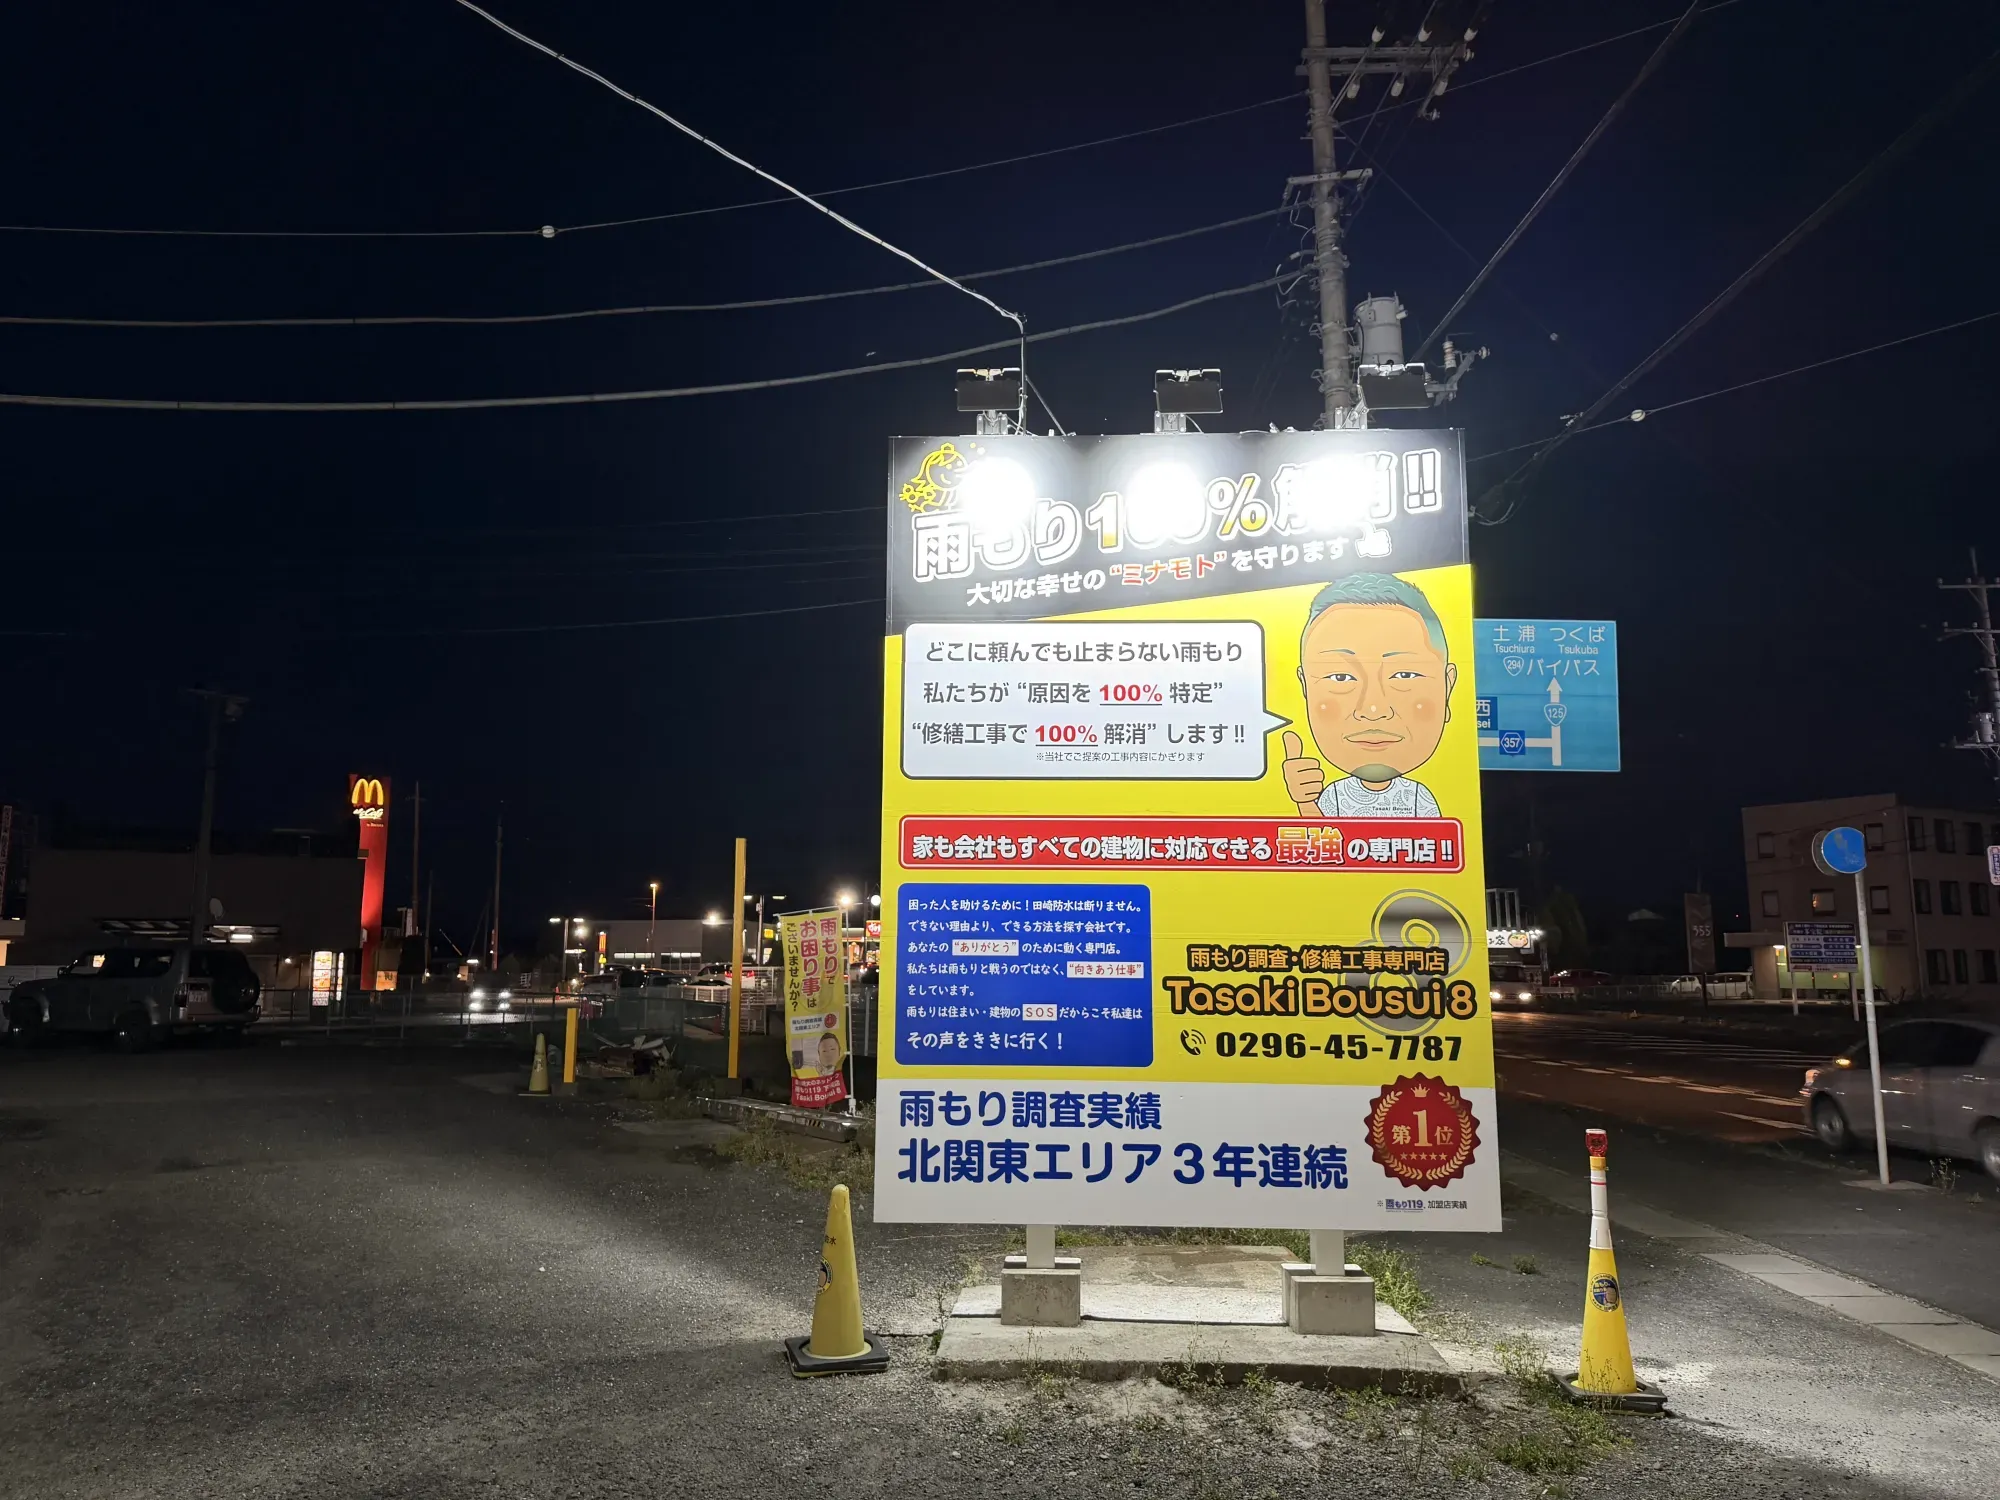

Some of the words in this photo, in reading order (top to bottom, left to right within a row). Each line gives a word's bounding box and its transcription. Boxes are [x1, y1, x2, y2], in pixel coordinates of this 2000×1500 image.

[966, 569, 1105, 606] 大切な幸せの
[1231, 536, 1350, 571] を守ります
[1493, 624, 1536, 642] 土浦
[1550, 626, 1606, 643] つくば
[926, 641, 1243, 663] どこに頼んでも止まらない雨もり
[1494, 644, 1535, 654] Tsuchiura
[1558, 644, 1599, 654] Tsukuba
[1507, 659, 1521, 669] 294
[1527, 658, 1600, 676] バイパス
[923, 681, 1010, 704] 私たちが
[1100, 684, 1163, 702] 100%
[1548, 708, 1564, 719] 125
[1035, 725, 1098, 743] 100%
[1503, 735, 1520, 748] 357
[912, 834, 1273, 861] 家も会社もすべての建物に対応できる
[1276, 826, 1344, 865] 最強
[1347, 836, 1454, 862] の専門店!!
[908, 899, 1142, 912] 困った人を助けるために！田崎防水は断りません。
[908, 920, 1131, 933] できない理由より、できる方法を探す会社です。
[820, 917, 838, 984] 雨もりで
[907, 941, 949, 953] あなたの
[1022, 942, 1121, 955] のために動く専門店。
[800, 920, 820, 1008] お困り事は
[1189, 946, 1446, 973] 雨もり調査・修繕工事専門店
[907, 963, 1065, 976] 私たちは雨もりと戦うのではなく、
[907, 984, 975, 997] をしています。
[1164, 976, 1298, 1014] Tasaki
[1304, 977, 1443, 1016] Bousui
[1448, 983, 1475, 1017] 8
[906, 1006, 1021, 1018] 雨もりは住まい・建物の
[1025, 1007, 1055, 1018] SOS
[1059, 1007, 1143, 1020] だからこそ私達は
[907, 1030, 1063, 1050] その声をききに行く！
[1216, 1031, 1462, 1062] 0296-45-7787
[899, 1090, 1162, 1130] 雨もり調査実績
[1392, 1109, 1454, 1147] 第1位
